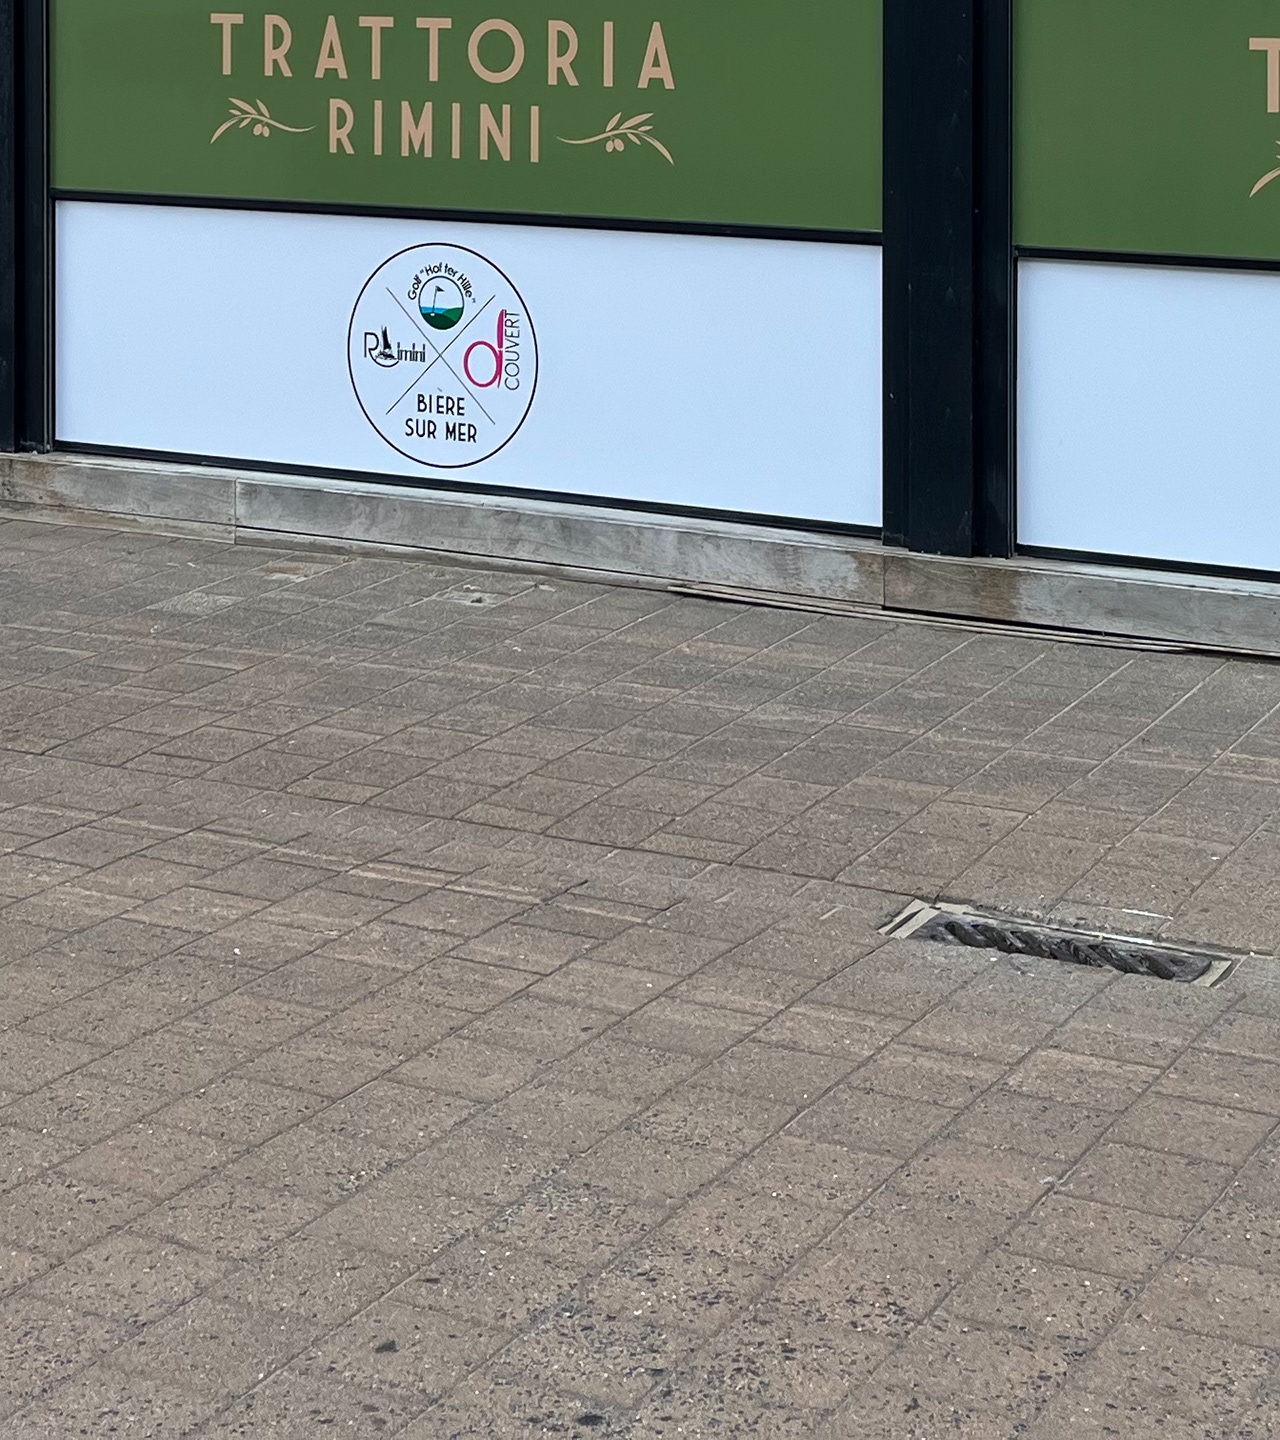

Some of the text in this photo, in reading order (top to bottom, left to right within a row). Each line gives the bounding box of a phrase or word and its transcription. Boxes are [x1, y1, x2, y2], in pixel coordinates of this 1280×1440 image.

[210, 12, 676, 90] TRATTORIA
[328, 98, 540, 163] RIMINI
[363, 331, 426, 368] Rimini
[504, 310, 521, 391] COUVERT
[405, 418, 478, 444] SUR MER
